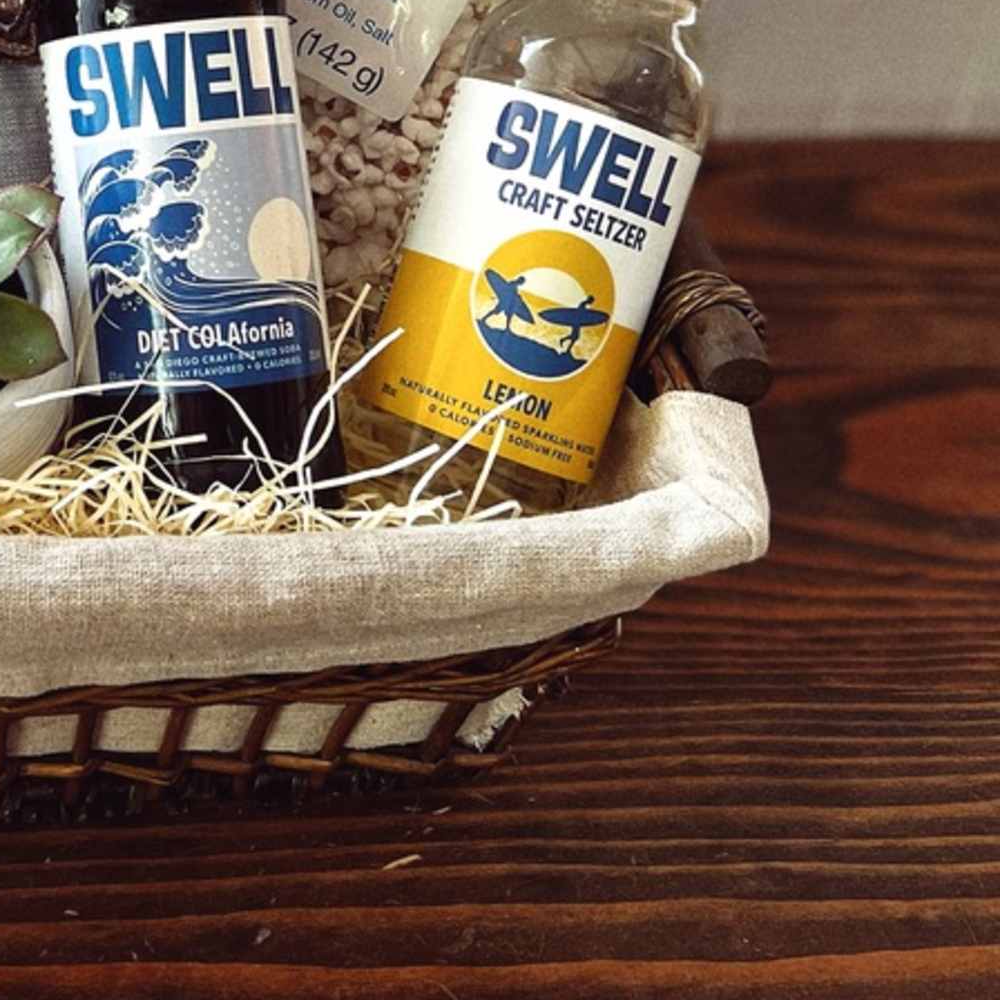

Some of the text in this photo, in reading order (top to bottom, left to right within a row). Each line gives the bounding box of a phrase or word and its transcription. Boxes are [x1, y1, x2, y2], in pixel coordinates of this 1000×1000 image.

[64, 26, 295, 138] SWELL
[296, 27, 385, 96] (142 g)
[486, 99, 678, 227] SWELL
[497, 179, 648, 252] CRAFT SELTZER
[136, 315, 295, 354] DIET COLAfornia
[399, 376, 458, 407] NATURALLY
